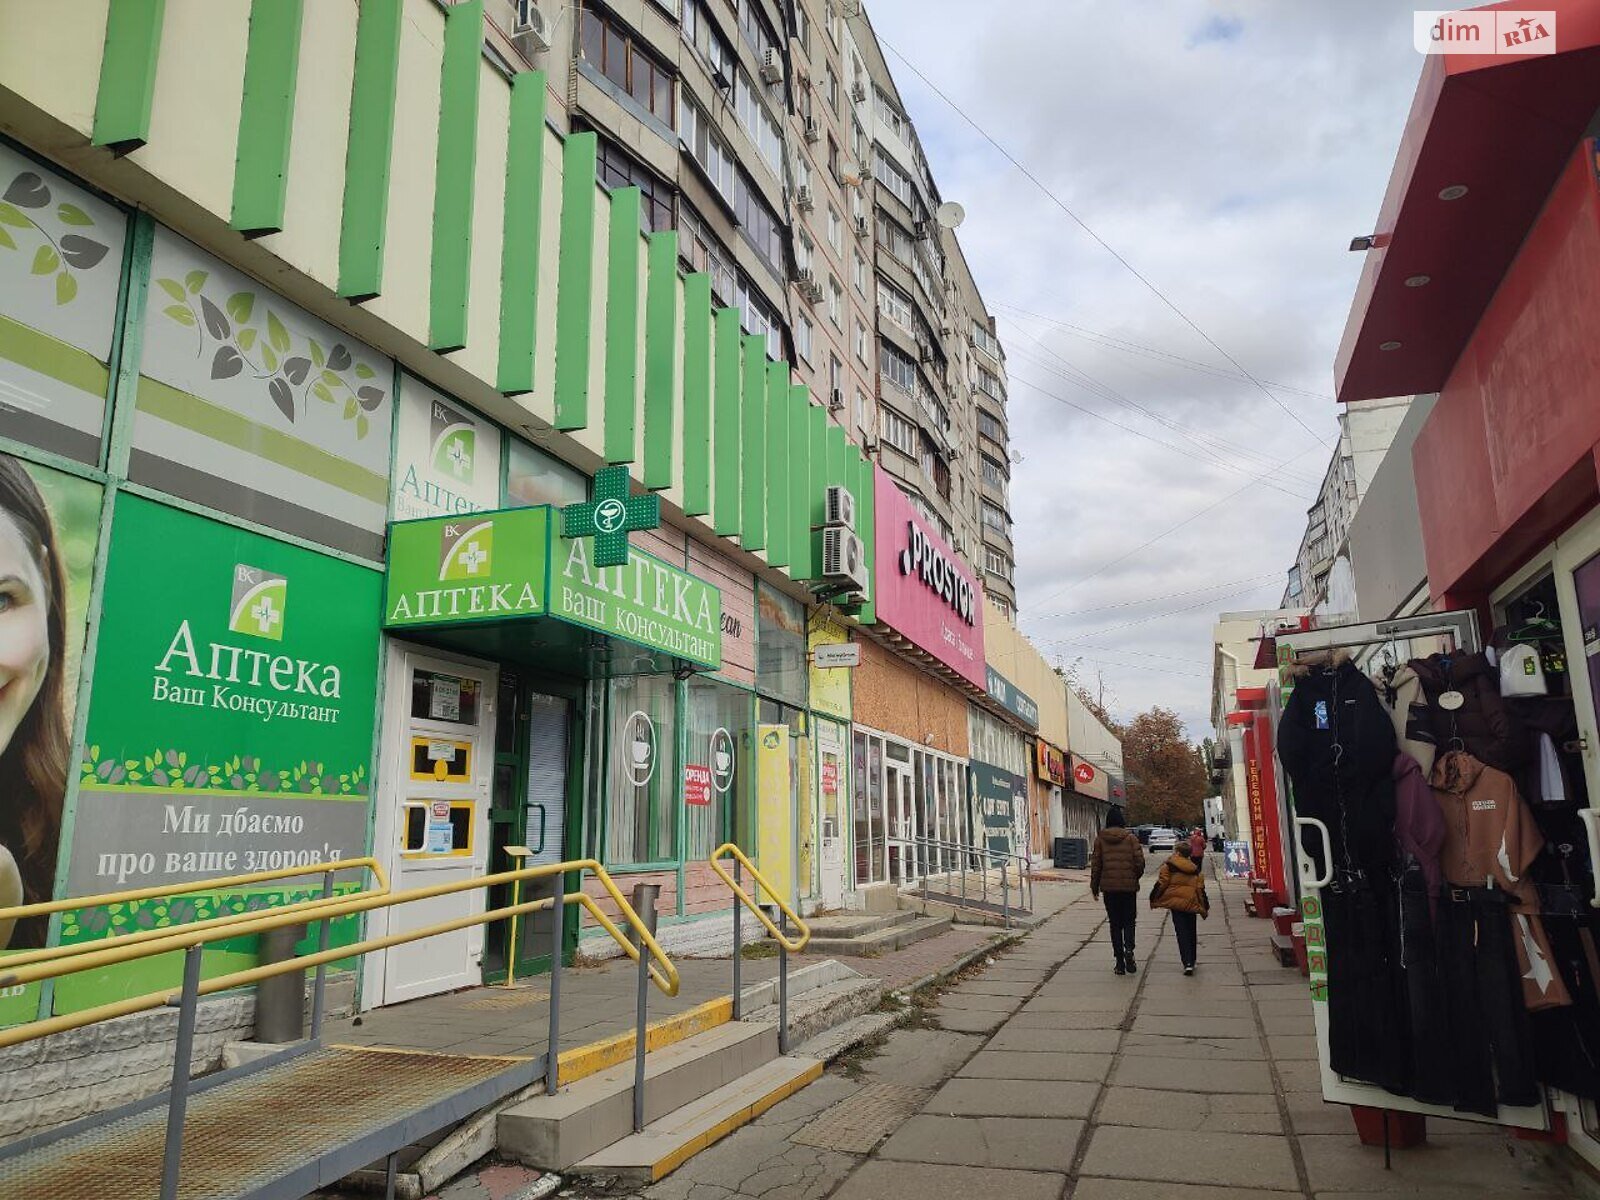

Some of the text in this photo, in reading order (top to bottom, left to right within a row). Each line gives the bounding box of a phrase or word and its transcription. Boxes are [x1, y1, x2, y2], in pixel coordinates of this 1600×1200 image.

[400, 464, 482, 513] Аптек
[907, 520, 976, 627] PROSTOR
[390, 582, 540, 620] АПТЕКА
[720, 612, 741, 638] ean
[154, 619, 341, 699] Аптека
[152, 675, 340, 723] Ваш Консультант
[161, 804, 304, 838] Ми дбаємо
[96, 842, 342, 884] про ваше здоров'я
